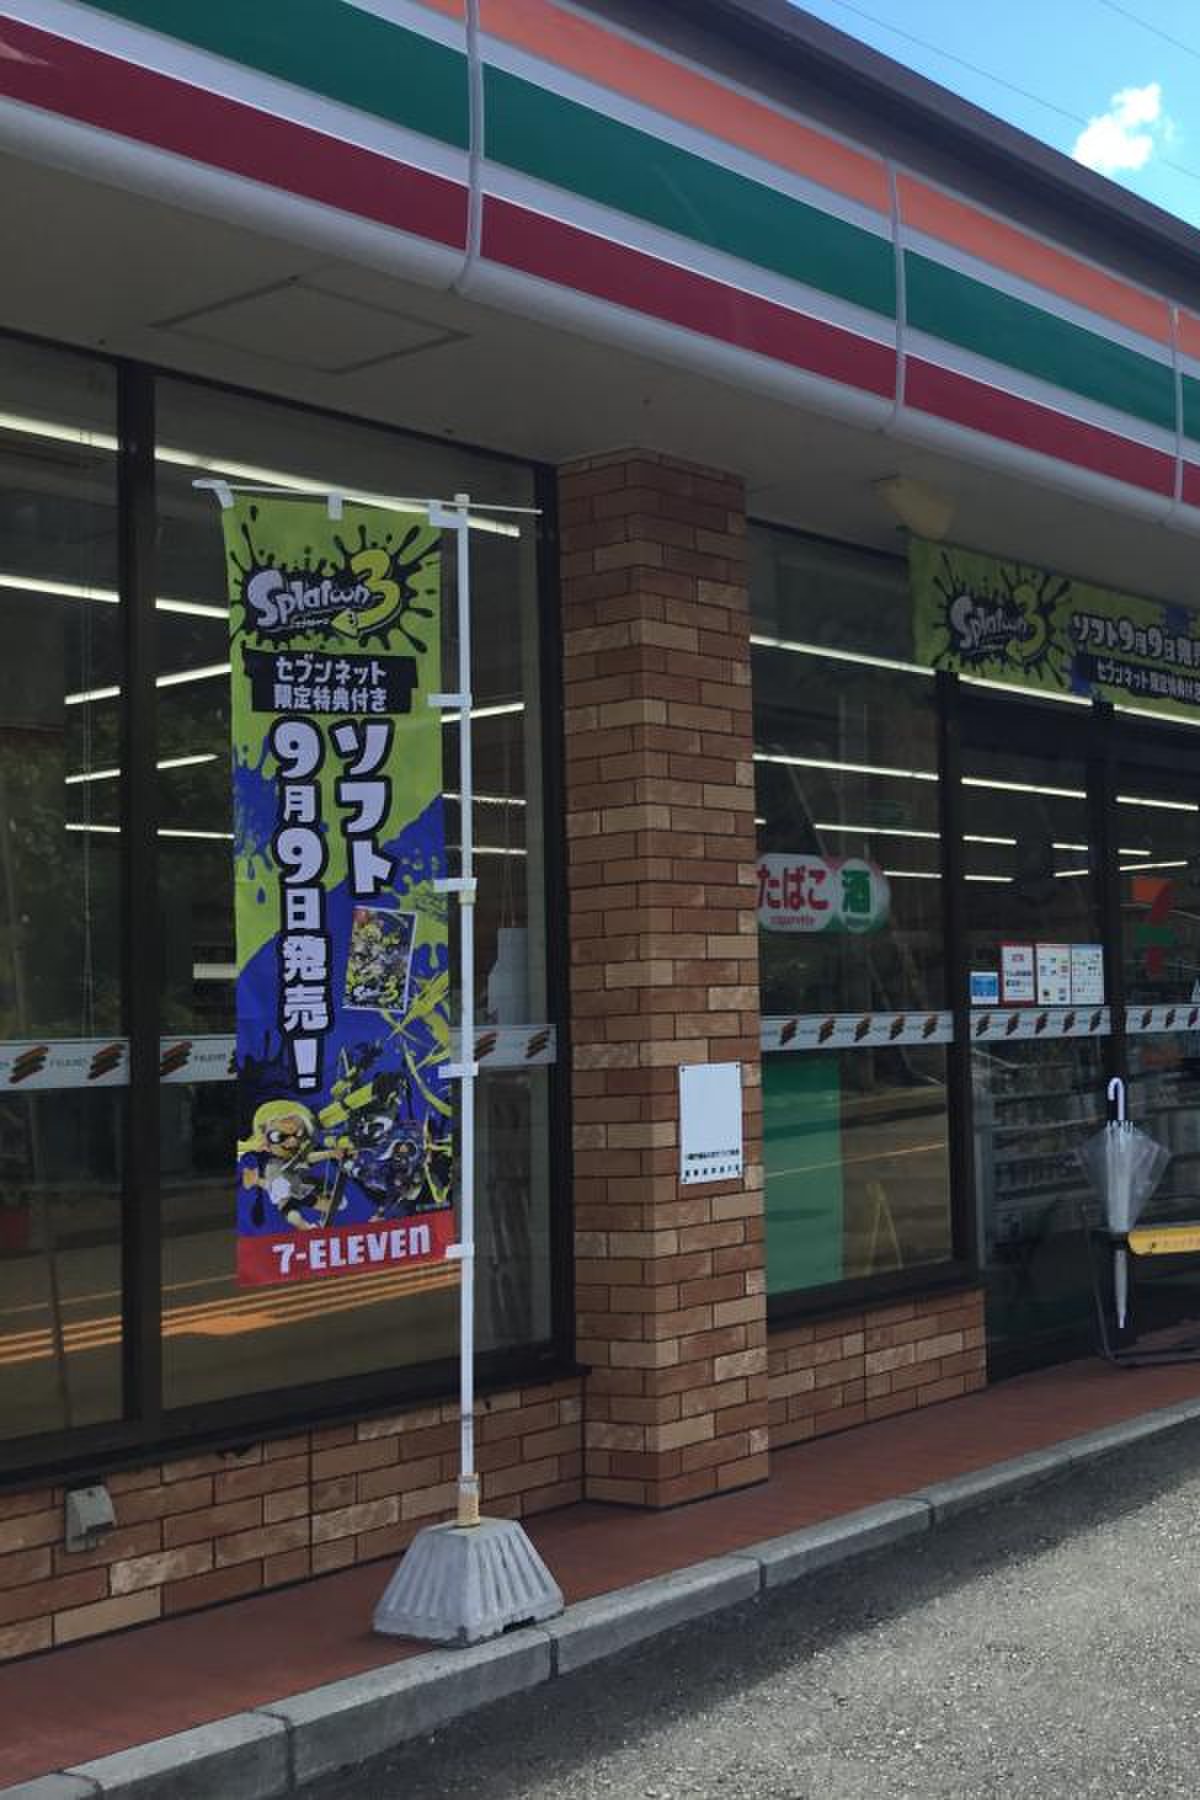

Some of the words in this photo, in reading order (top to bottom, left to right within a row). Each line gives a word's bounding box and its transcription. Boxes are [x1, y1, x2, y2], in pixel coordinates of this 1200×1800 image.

[330, 548, 401, 638] 3
[273, 683, 388, 712] 限定特典付き
[275, 653, 388, 684] セブンネット
[333, 722, 394, 895] ソフト
[271, 719, 331, 1090] 9月9日発売!
[757, 863, 831, 911] たばこ
